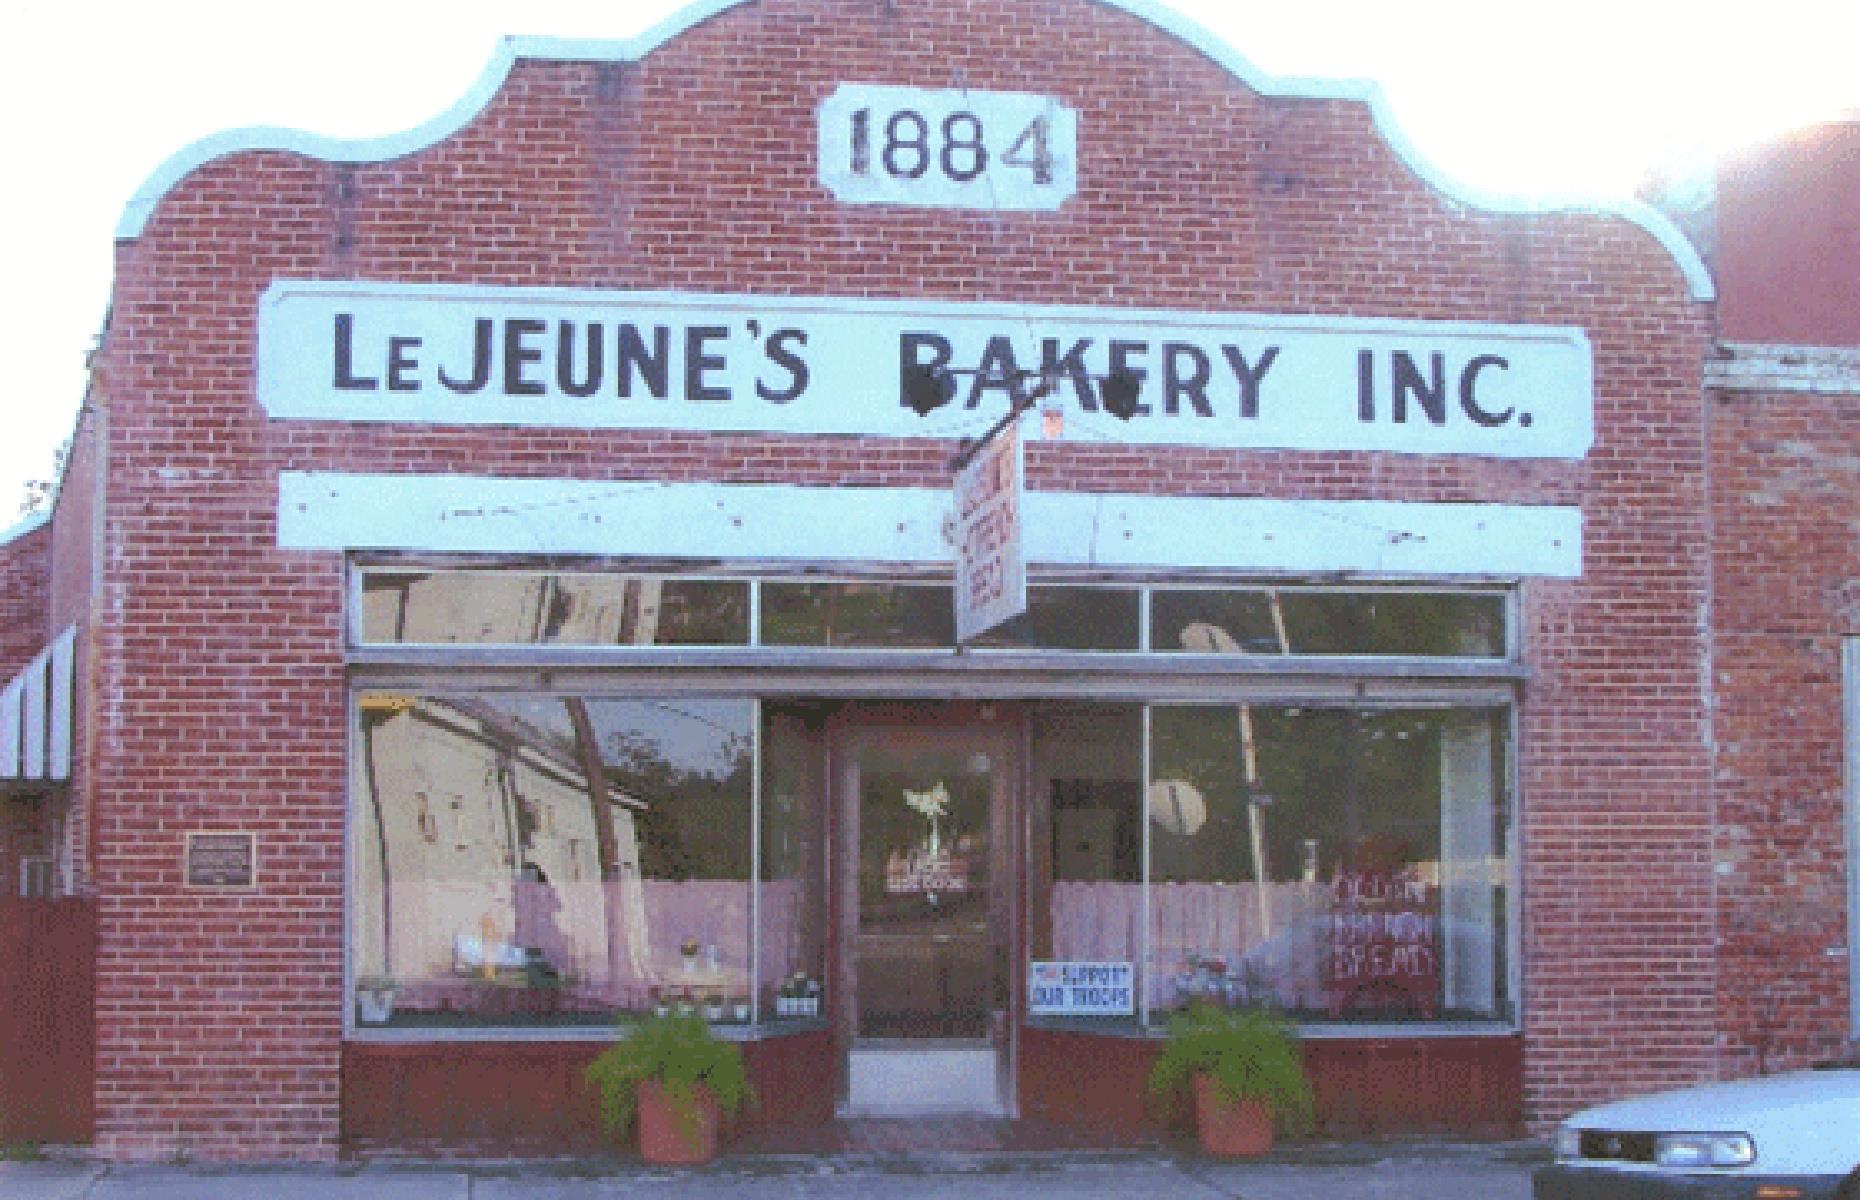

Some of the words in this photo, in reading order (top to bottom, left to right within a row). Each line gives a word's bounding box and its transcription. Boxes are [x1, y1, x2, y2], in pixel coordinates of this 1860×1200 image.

[849, 107, 1054, 185] 1884
[900, 331, 1281, 418] BAKERY
[1356, 348, 1534, 428] INC.
